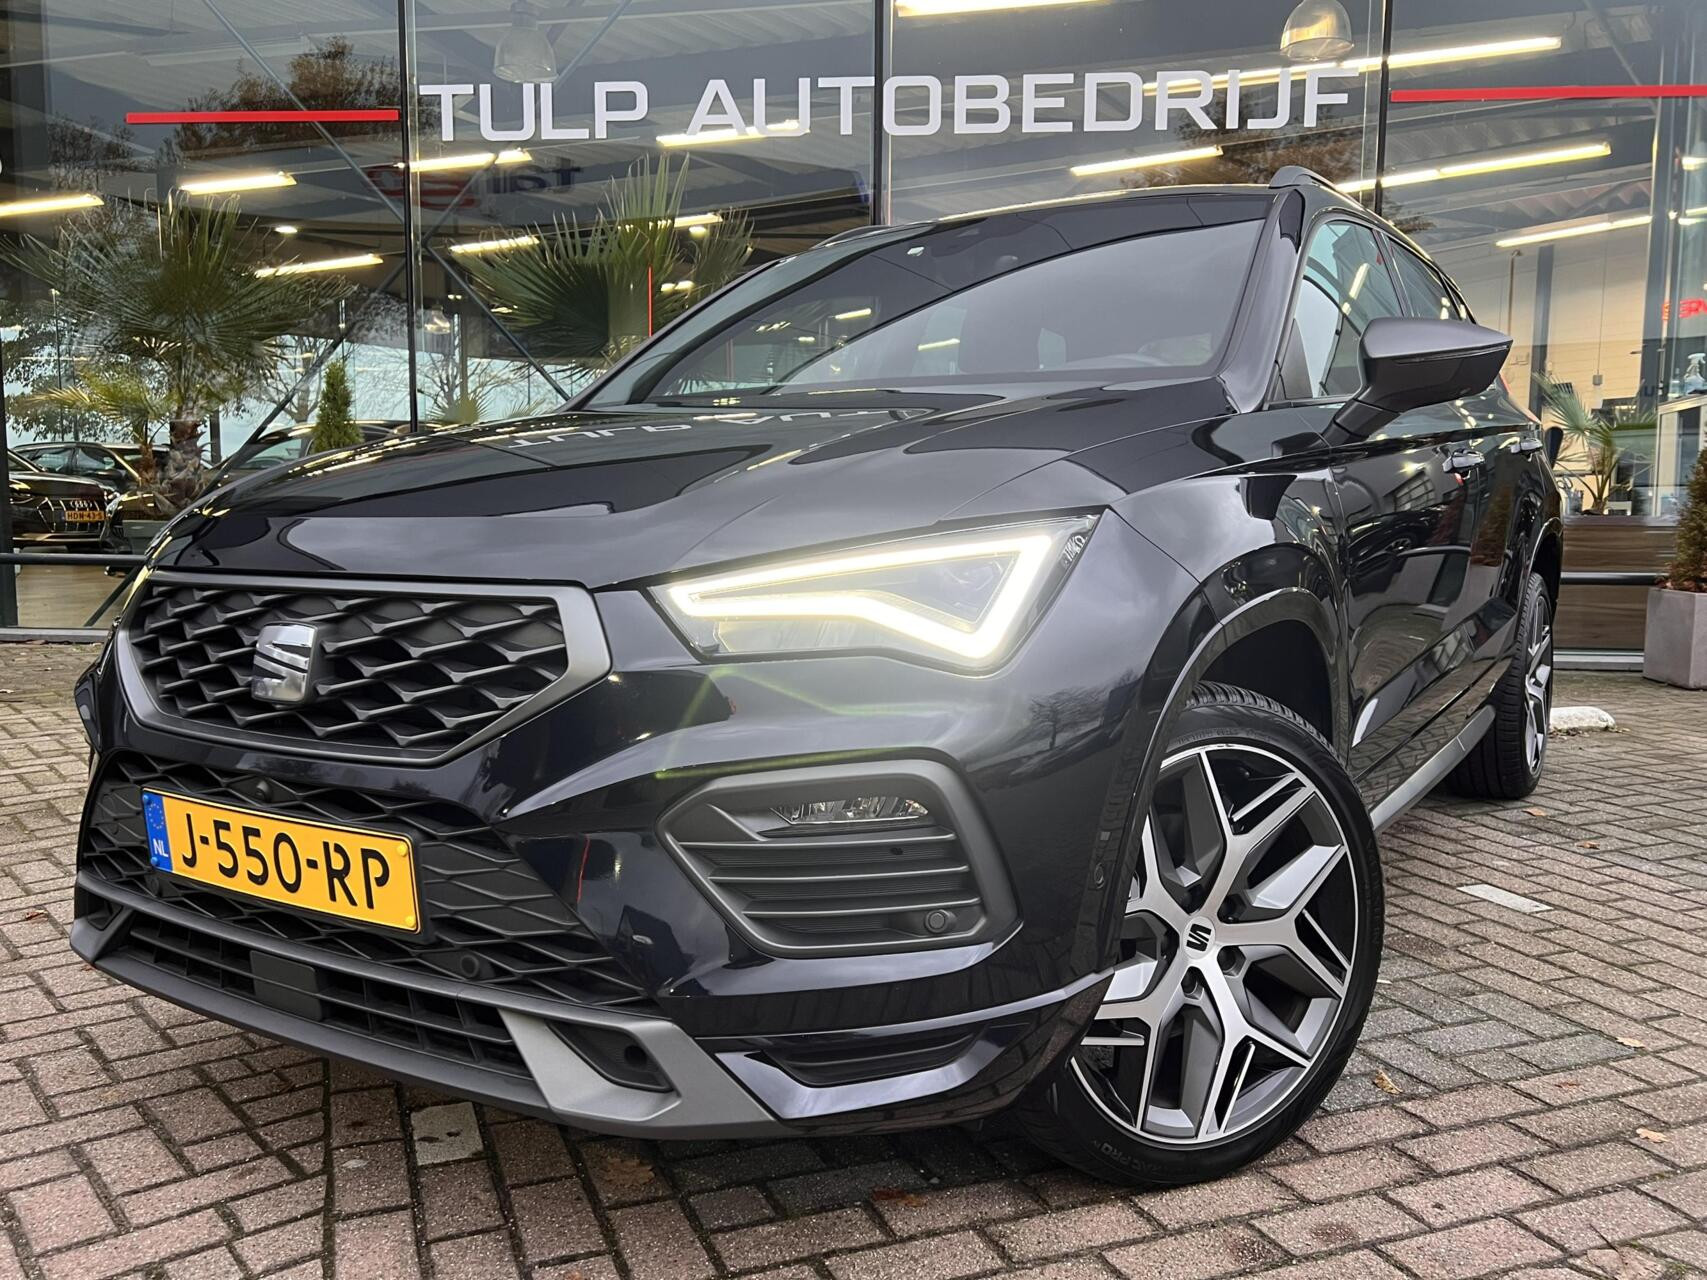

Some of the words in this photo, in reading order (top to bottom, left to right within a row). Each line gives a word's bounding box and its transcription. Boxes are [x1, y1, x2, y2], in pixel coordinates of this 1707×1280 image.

[420, 80, 648, 142] TULP
[686, 66, 1359, 137] AUTOBEDRIJF
[153, 838, 169, 858] NL
[182, 813, 390, 910] J-550-RP
